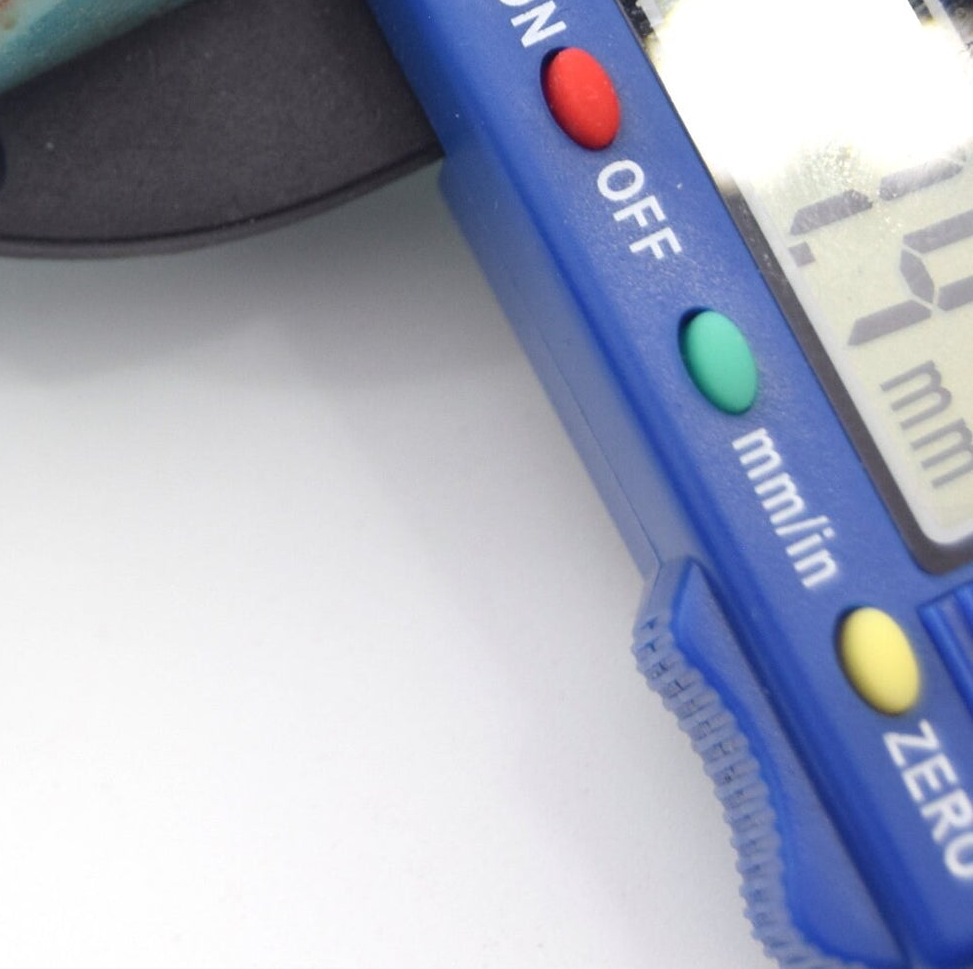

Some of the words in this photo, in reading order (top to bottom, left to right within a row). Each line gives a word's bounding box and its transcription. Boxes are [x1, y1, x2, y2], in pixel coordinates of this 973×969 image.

[597, 159, 683, 260] OFF
[731, 427, 841, 590] mm/in
[882, 718, 973, 881] ZERO
[880, 359, 973, 489] mm
